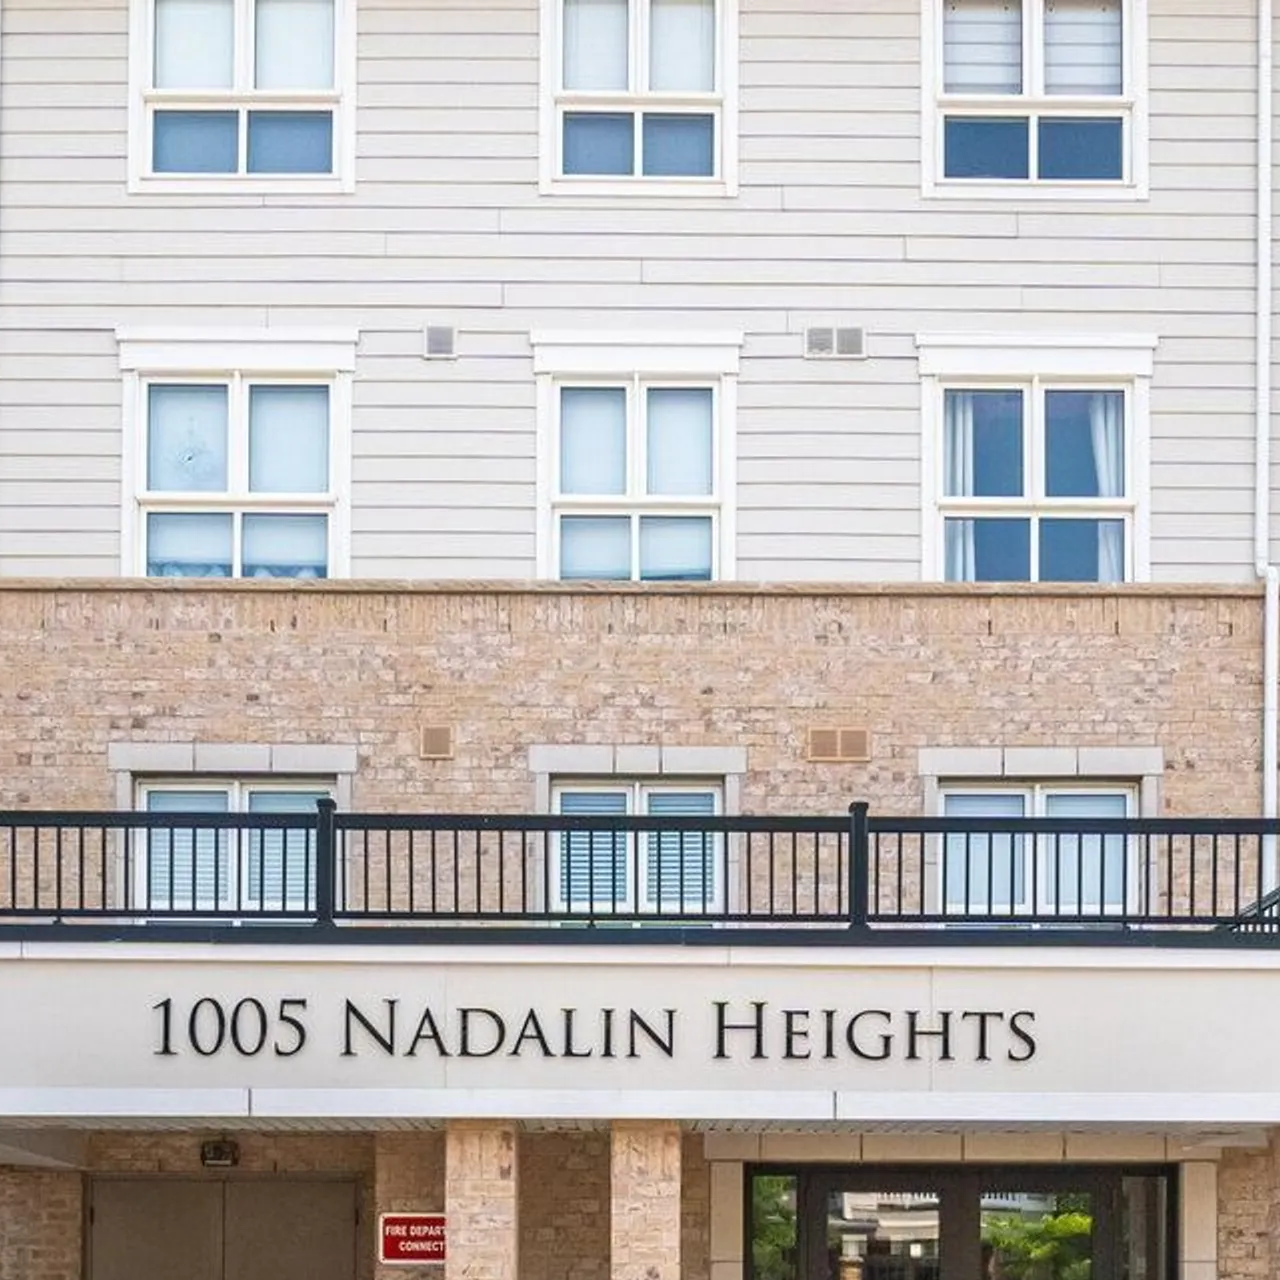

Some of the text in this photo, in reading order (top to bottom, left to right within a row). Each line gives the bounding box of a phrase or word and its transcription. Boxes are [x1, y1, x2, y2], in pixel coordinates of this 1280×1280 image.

[152, 997, 1037, 1062] 1005 NADALIN HEIGHTS
[385, 1226, 408, 1236] FIRE
